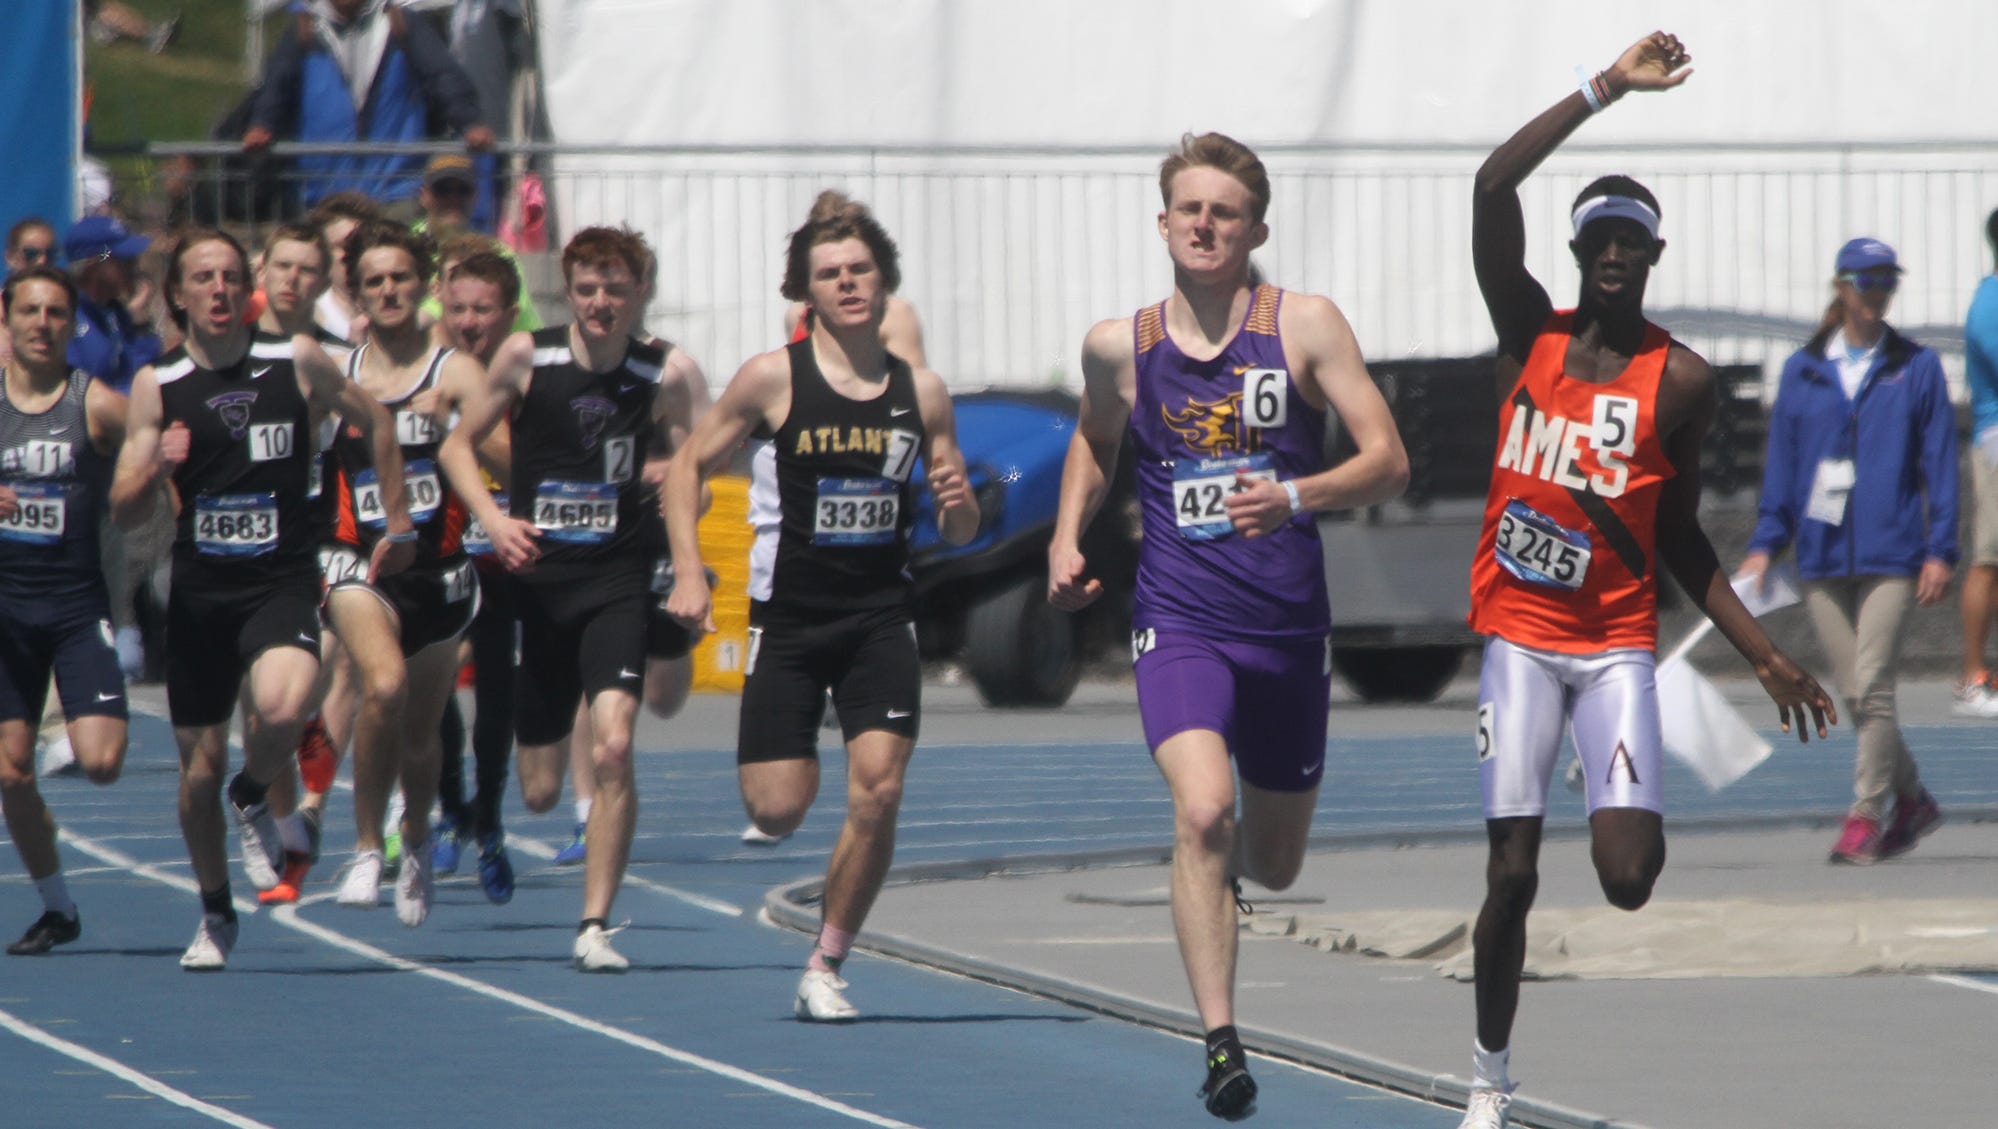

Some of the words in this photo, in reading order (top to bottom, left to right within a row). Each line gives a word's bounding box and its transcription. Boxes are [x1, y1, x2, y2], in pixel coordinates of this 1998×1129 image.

[1255, 373, 1279, 423] 6
[259, 424, 289, 458] 10
[405, 413, 435, 442] 14
[1602, 400, 1628, 448] 5
[36, 444, 61, 474] 11
[612, 440, 630, 481] 2
[894, 434, 915, 476] 7
[1498, 404, 1629, 499] AMES
[0, 503, 59, 529] 095
[200, 513, 272, 540] 4683
[540, 503, 612, 528] 4685
[820, 500, 894, 528] 3338
[1497, 516, 1581, 582] 3245
